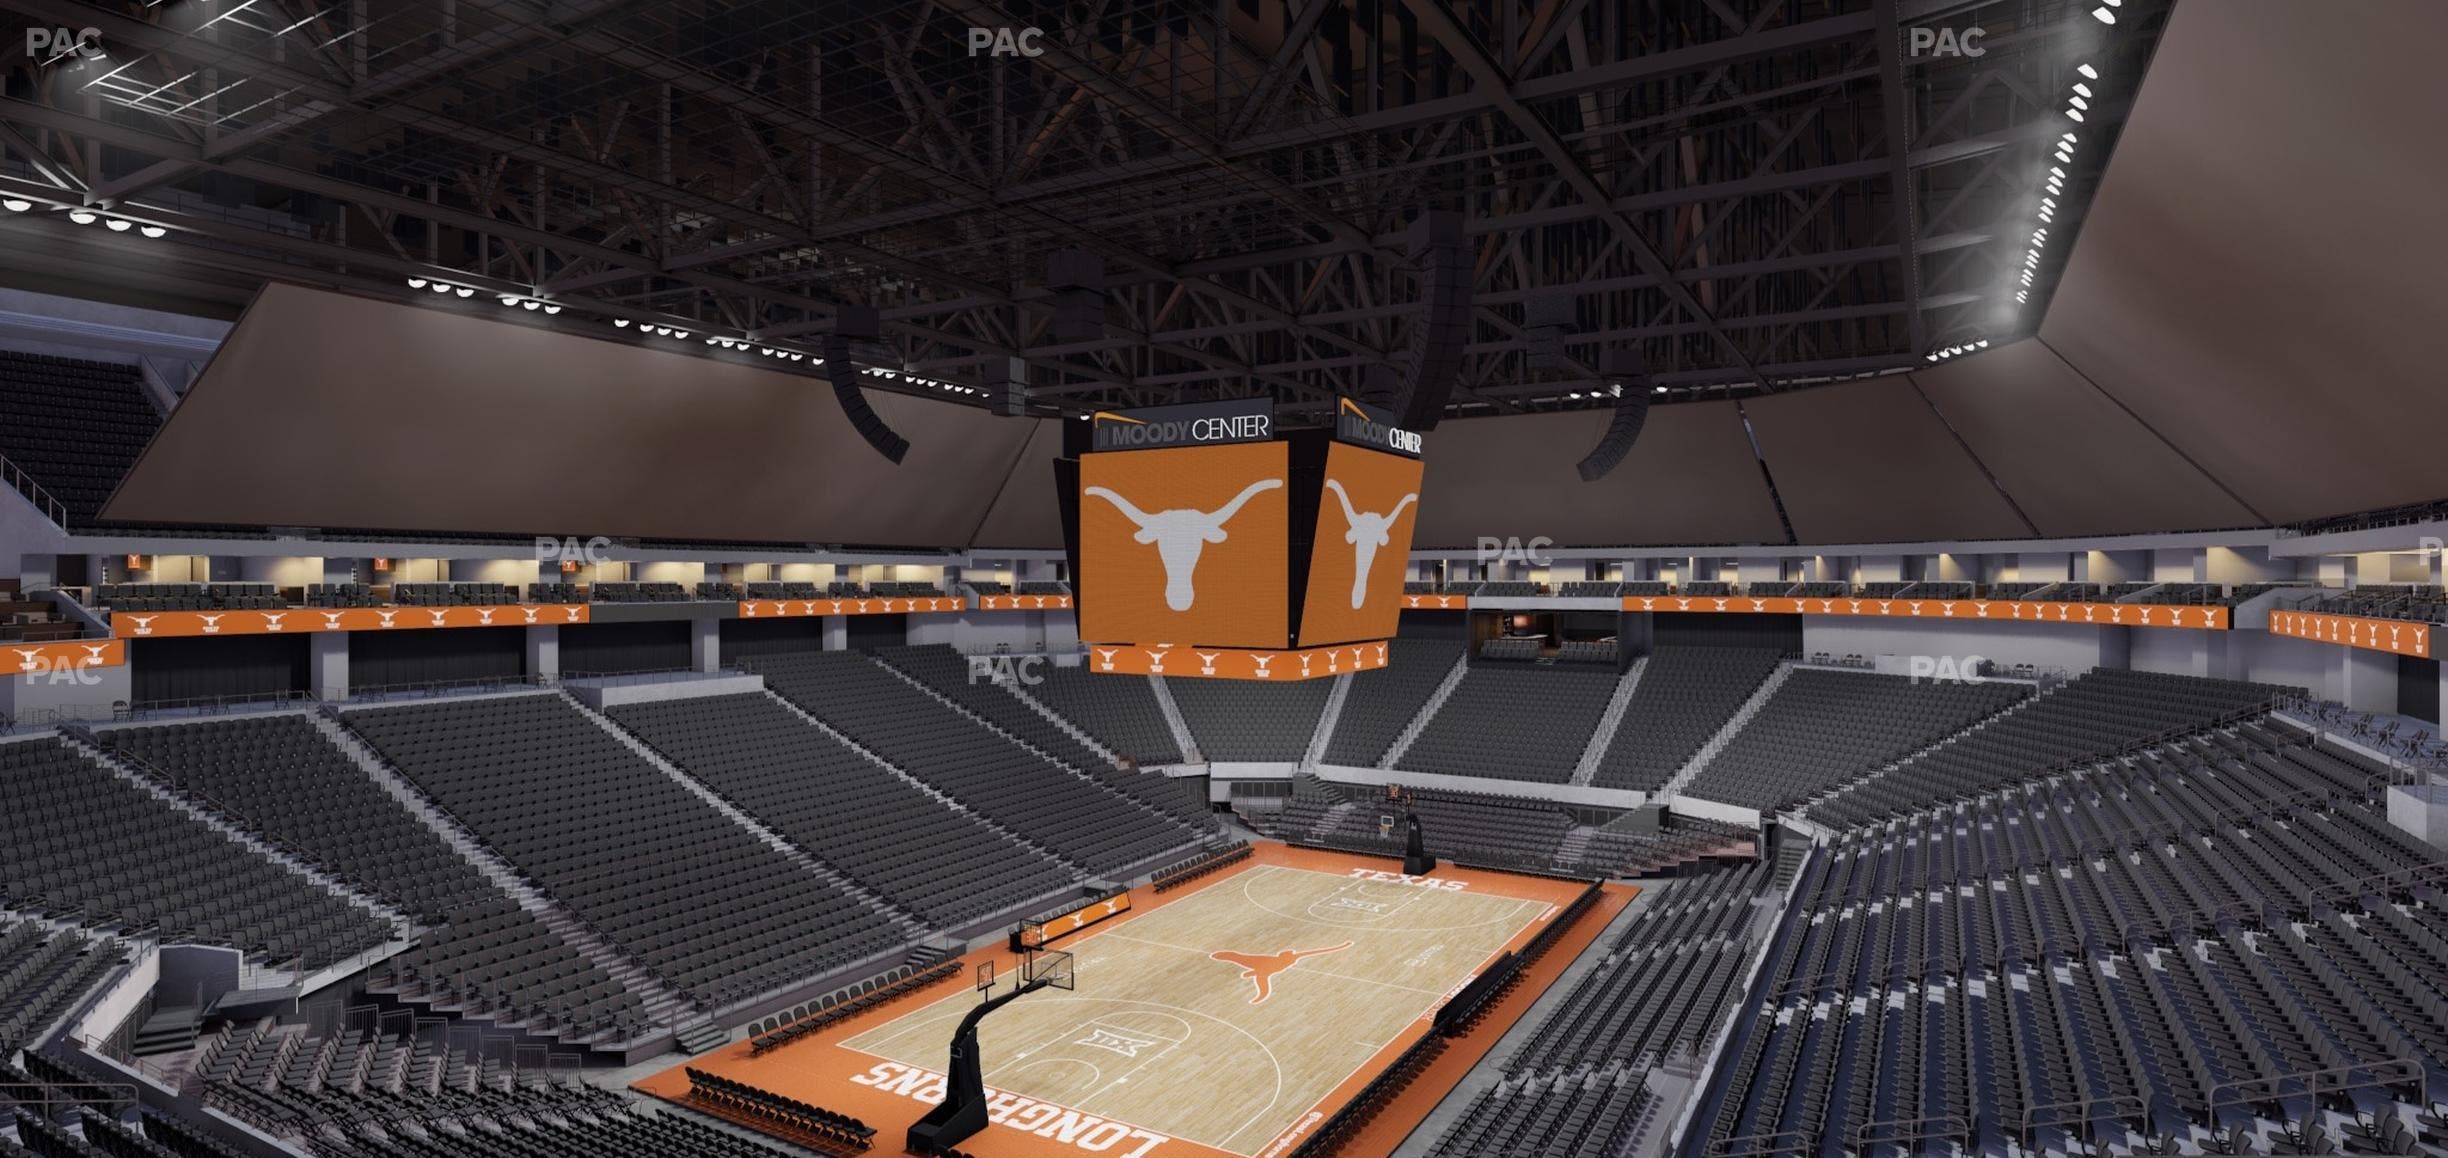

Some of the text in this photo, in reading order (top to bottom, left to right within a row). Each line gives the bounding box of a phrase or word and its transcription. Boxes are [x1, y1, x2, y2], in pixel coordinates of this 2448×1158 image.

[1112, 414, 1270, 446] MOODY CENTER
[1352, 416, 1422, 454] MOODY CENTER
[1349, 867, 1470, 892] TEXAS
[849, 1060, 1170, 1158] LONGHRNS
